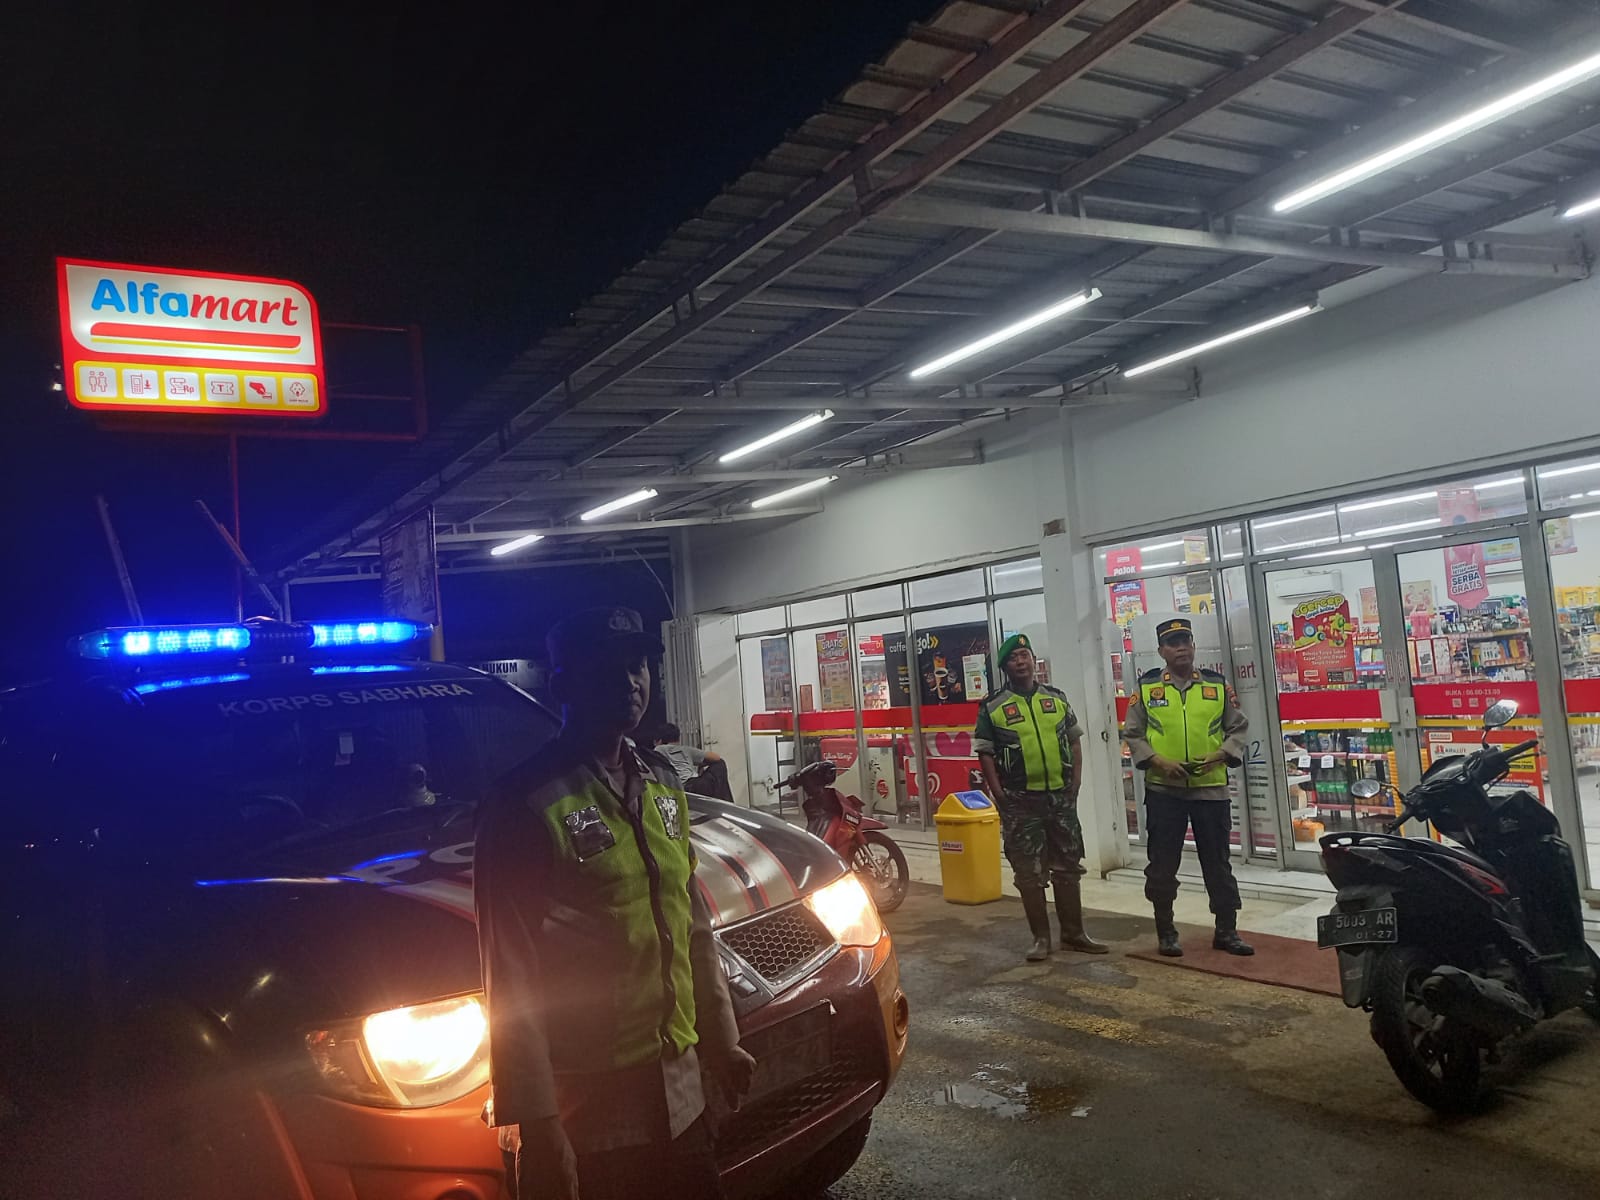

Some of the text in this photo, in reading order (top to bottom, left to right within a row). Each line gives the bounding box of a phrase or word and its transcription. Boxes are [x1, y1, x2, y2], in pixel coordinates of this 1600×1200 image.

[91, 278, 299, 327] Alfamart
[1451, 580, 1483, 594] GRATIS
[1452, 572, 1480, 586] SERBA
[217, 682, 472, 718] KORPS SABHARA
[1335, 914, 1367, 929] 5003
[1376, 911, 1394, 926] AR
